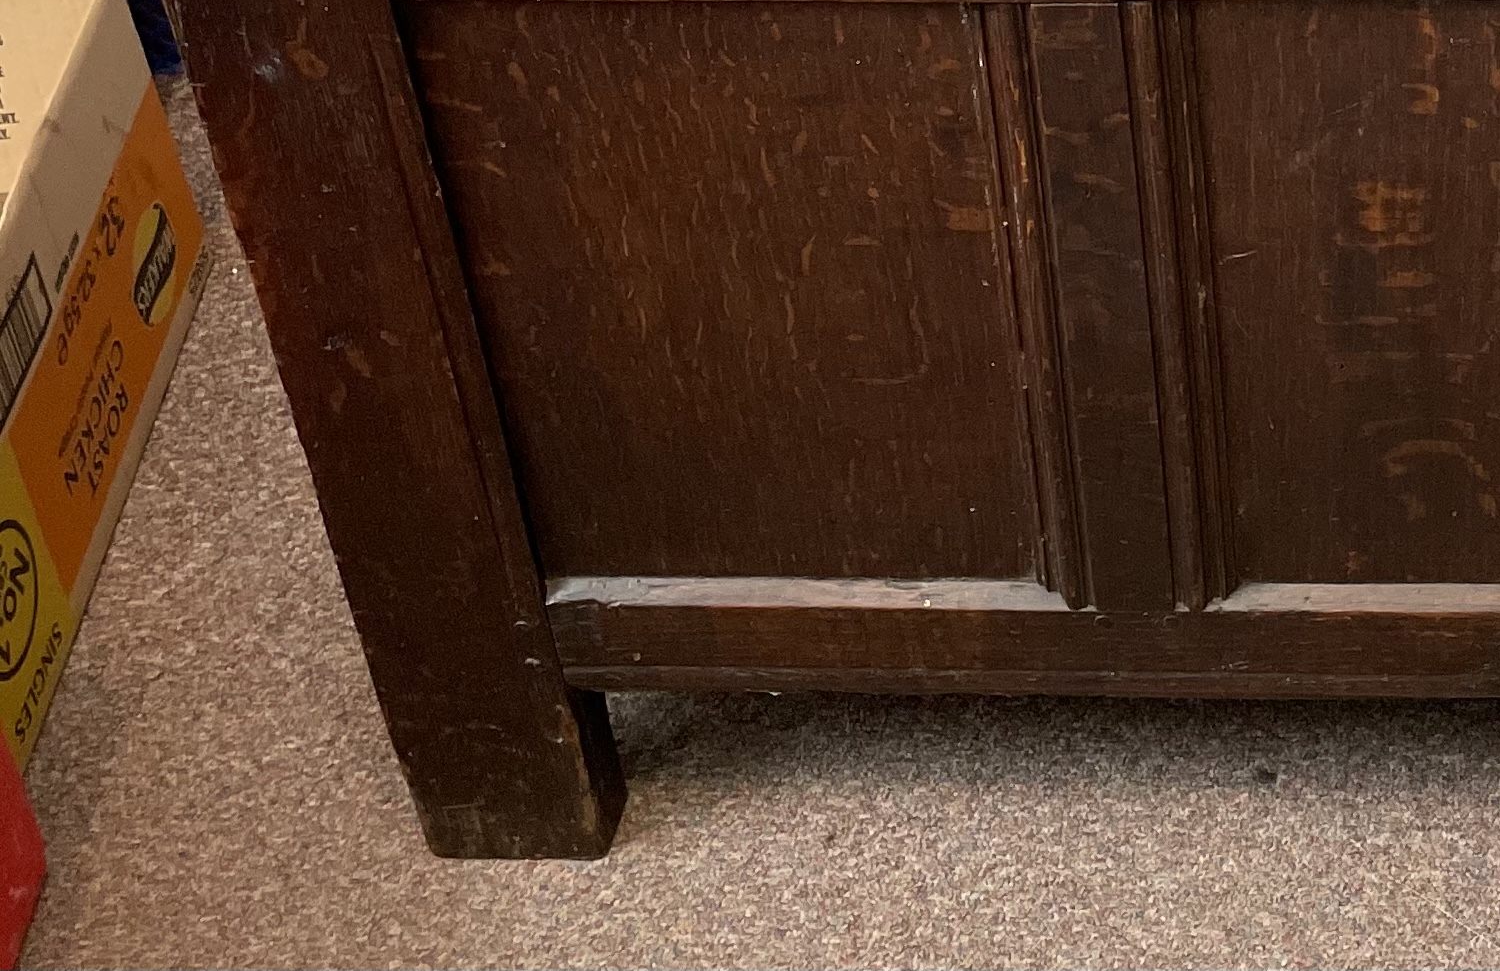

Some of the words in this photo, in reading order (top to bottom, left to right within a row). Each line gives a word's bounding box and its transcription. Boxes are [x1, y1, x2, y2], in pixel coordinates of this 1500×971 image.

[101, 198, 125, 257] 32
[63, 339, 124, 498] CHICKEN
[88, 383, 129, 499] ROAST
[14, 622, 64, 744] SINGLES
